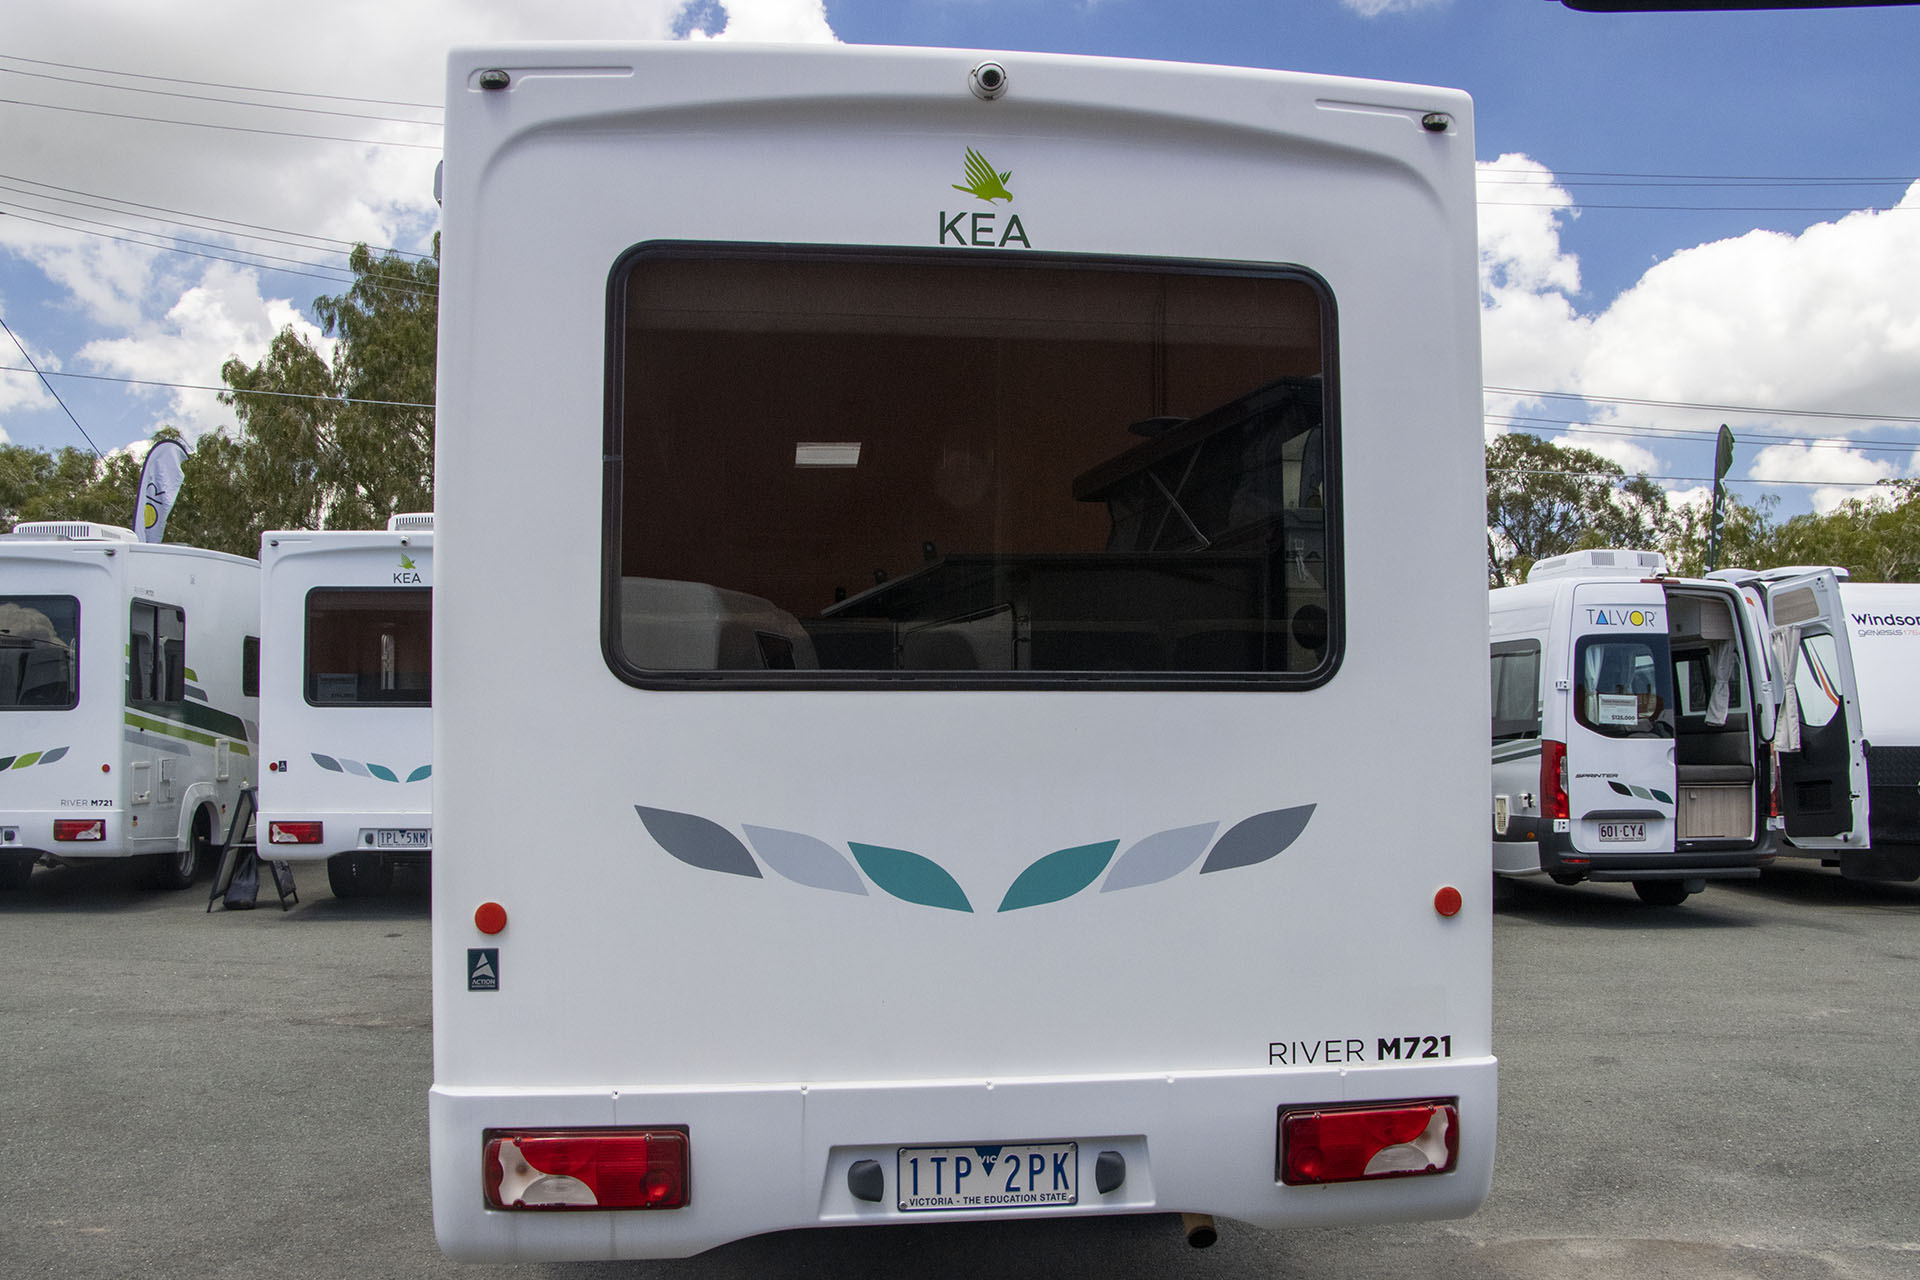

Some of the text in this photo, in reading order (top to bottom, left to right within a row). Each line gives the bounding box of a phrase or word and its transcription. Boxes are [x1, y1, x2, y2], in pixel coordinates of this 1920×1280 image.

[939, 211, 1032, 249] KEA
[393, 572, 422, 584] KEA
[1586, 609, 1656, 627] TALVOR
[1269, 1035, 1452, 1065] RIVER M721
[979, 1155, 998, 1164] VIC
[909, 1152, 1070, 1196] 1TP 2PK
[909, 1197, 954, 1207] VICTORIA
[963, 1196, 981, 1204] THE
[984, 1194, 1037, 1204] EDUCATION
[1039, 1192, 1067, 1201] STATE
